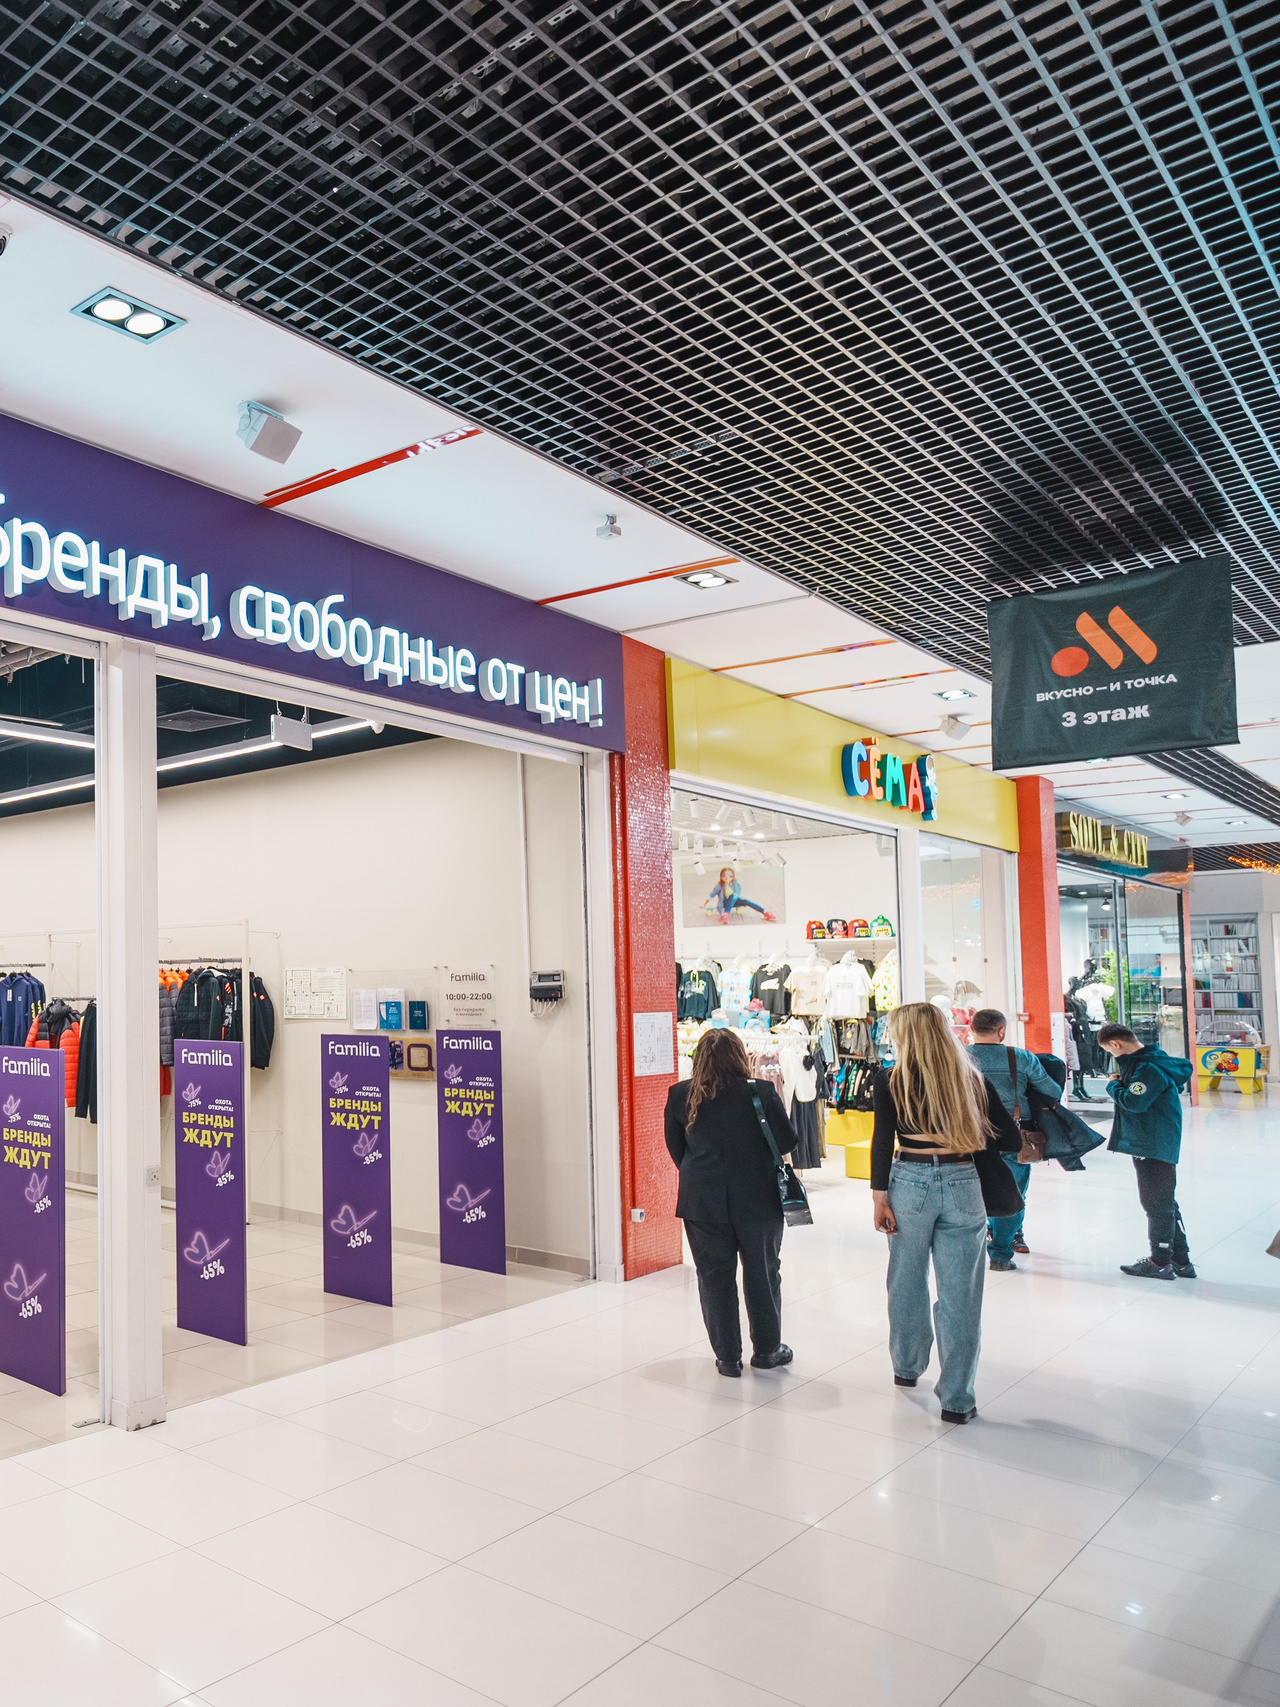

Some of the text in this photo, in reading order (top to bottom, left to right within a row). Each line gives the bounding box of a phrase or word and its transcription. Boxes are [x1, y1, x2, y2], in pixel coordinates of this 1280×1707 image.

[230, 583, 477, 693] свободные
[480, 656, 525, 705] от
[526, 666, 604, 728] цен!
[1036, 685, 1094, 703] ВКУСНО
[1124, 673, 1178, 688] ТОЧКА
[1061, 704, 1150, 728] 3 этаж
[1069, 811, 1106, 857] SOUL
[450, 972, 486, 982] familia
[445, 992, 492, 1001] 10:00-22:00
[328, 1041, 381, 1057] familia
[443, 1036, 493, 1051] familia
[2, 1056, 51, 1077] familia
[181, 1048, 233, 1067] familia
[444, 1087, 495, 1101] БРЕНДЫ
[329, 1097, 382, 1113] БРЕНДЫ
[445, 1100, 495, 1117] ЖДУТ
[182, 1111, 234, 1129] БРЕНДЫ
[330, 1111, 382, 1131] ЖДУТ
[2, 1127, 52, 1148] БРЕНДЫ
[183, 1127, 234, 1149] ЖДУТ
[477, 1133, 496, 1148] -85%
[3, 1145, 52, 1170] ЖДУТ
[363, 1149, 382, 1165] -85%
[215, 1170, 235, 1188] -85%
[34, 1195, 52, 1214] -85%
[462, 1205, 487, 1224] -65%
[347, 1229, 372, 1248] -65%
[200, 1258, 225, 1281] -65%
[18, 1295, 42, 1319] -65%
